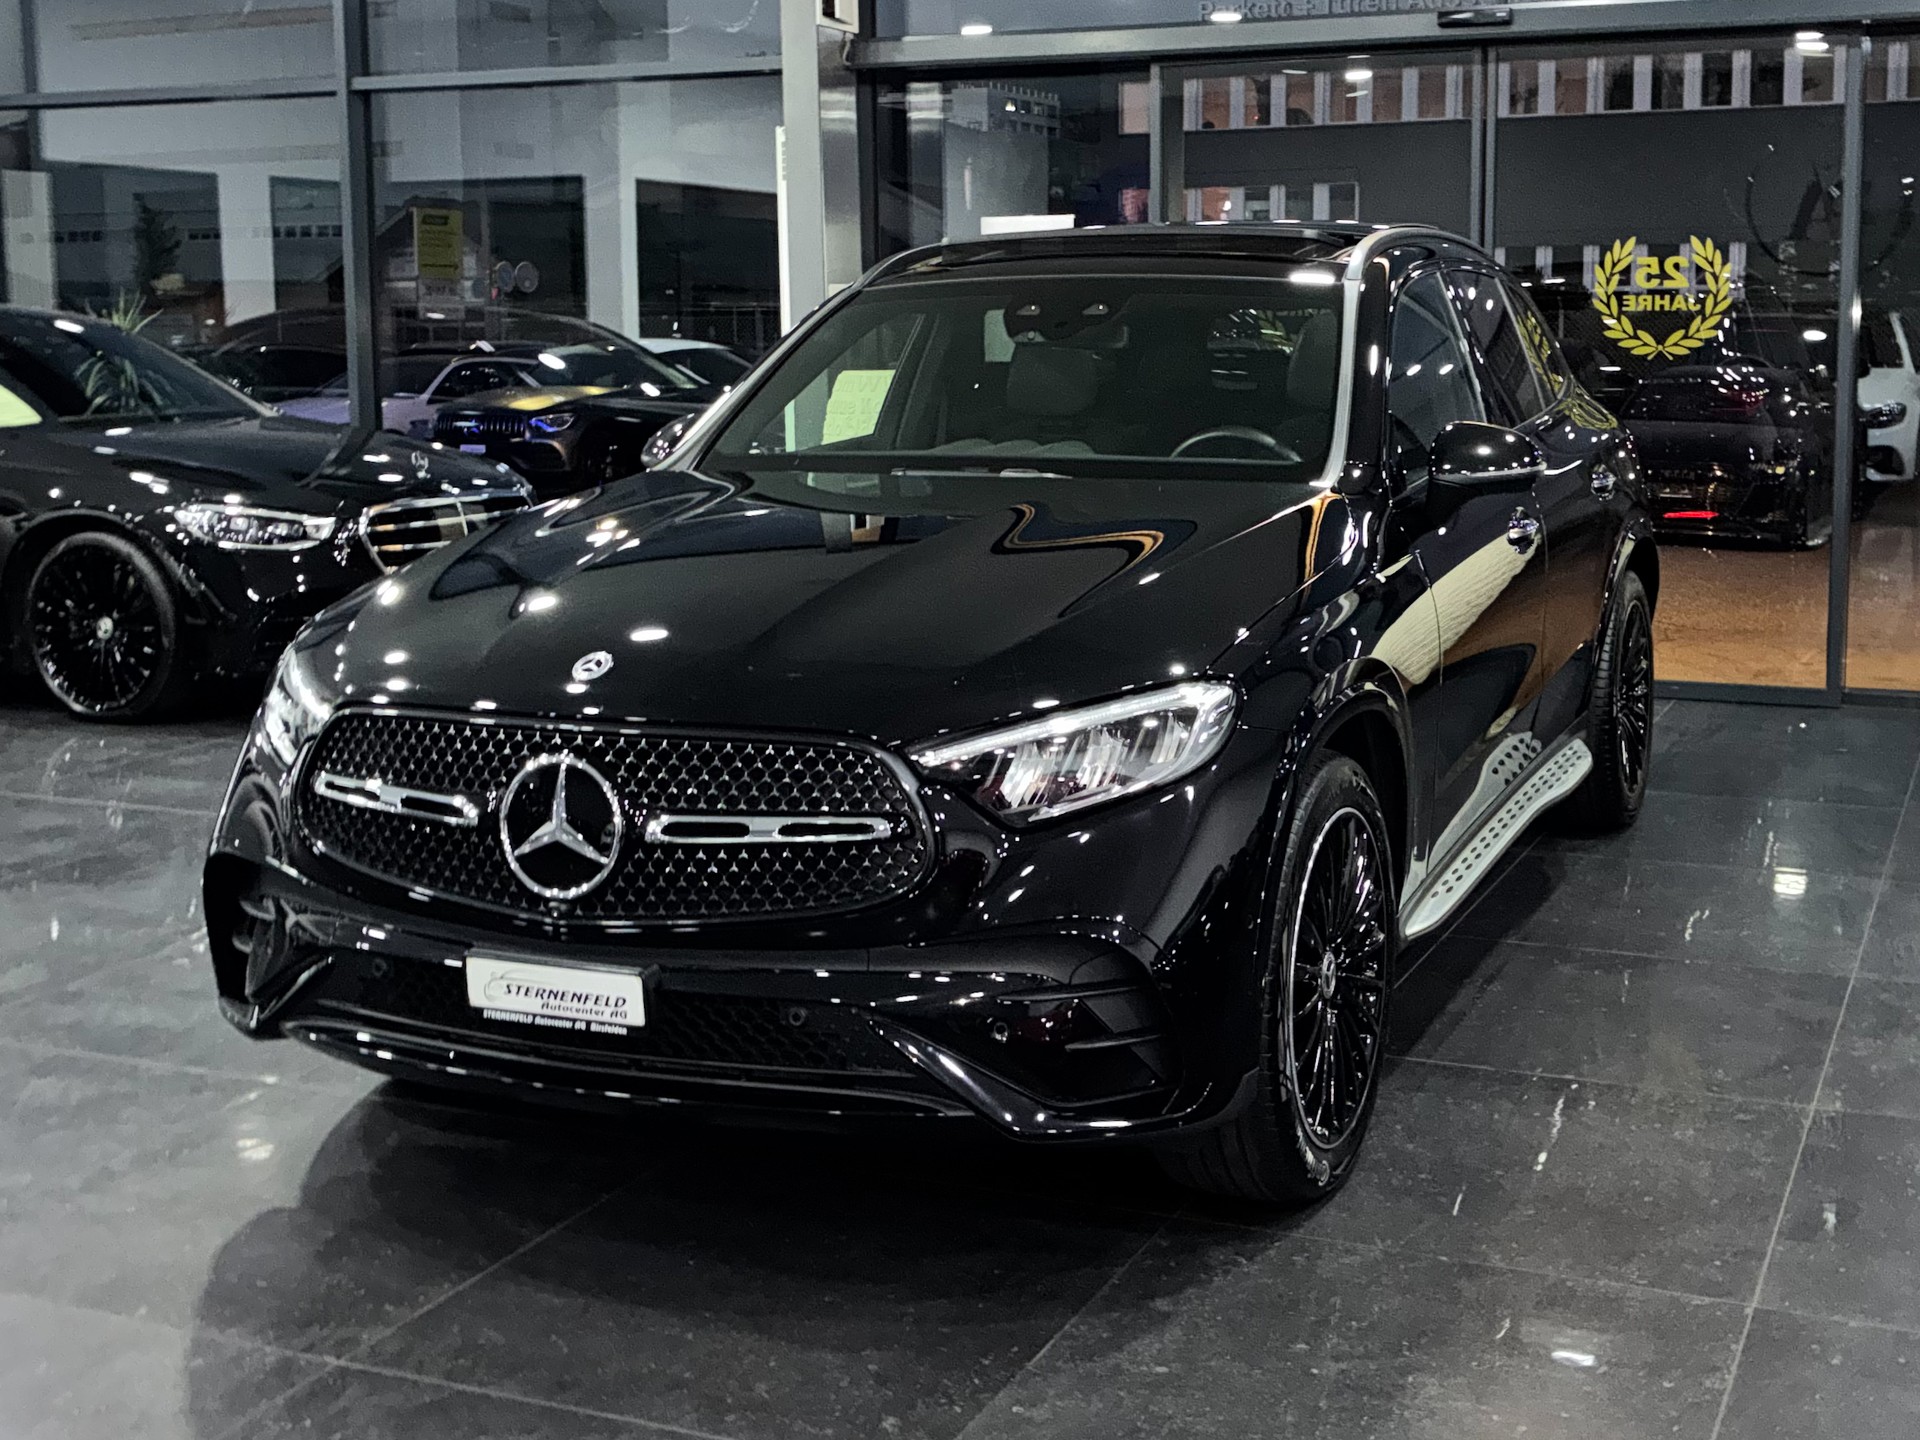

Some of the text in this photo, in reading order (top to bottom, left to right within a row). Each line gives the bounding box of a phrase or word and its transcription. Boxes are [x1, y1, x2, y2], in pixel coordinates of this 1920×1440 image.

[504, 984, 627, 1008] STERNENFELD
[541, 1001, 627, 1020] Autocenter AG
